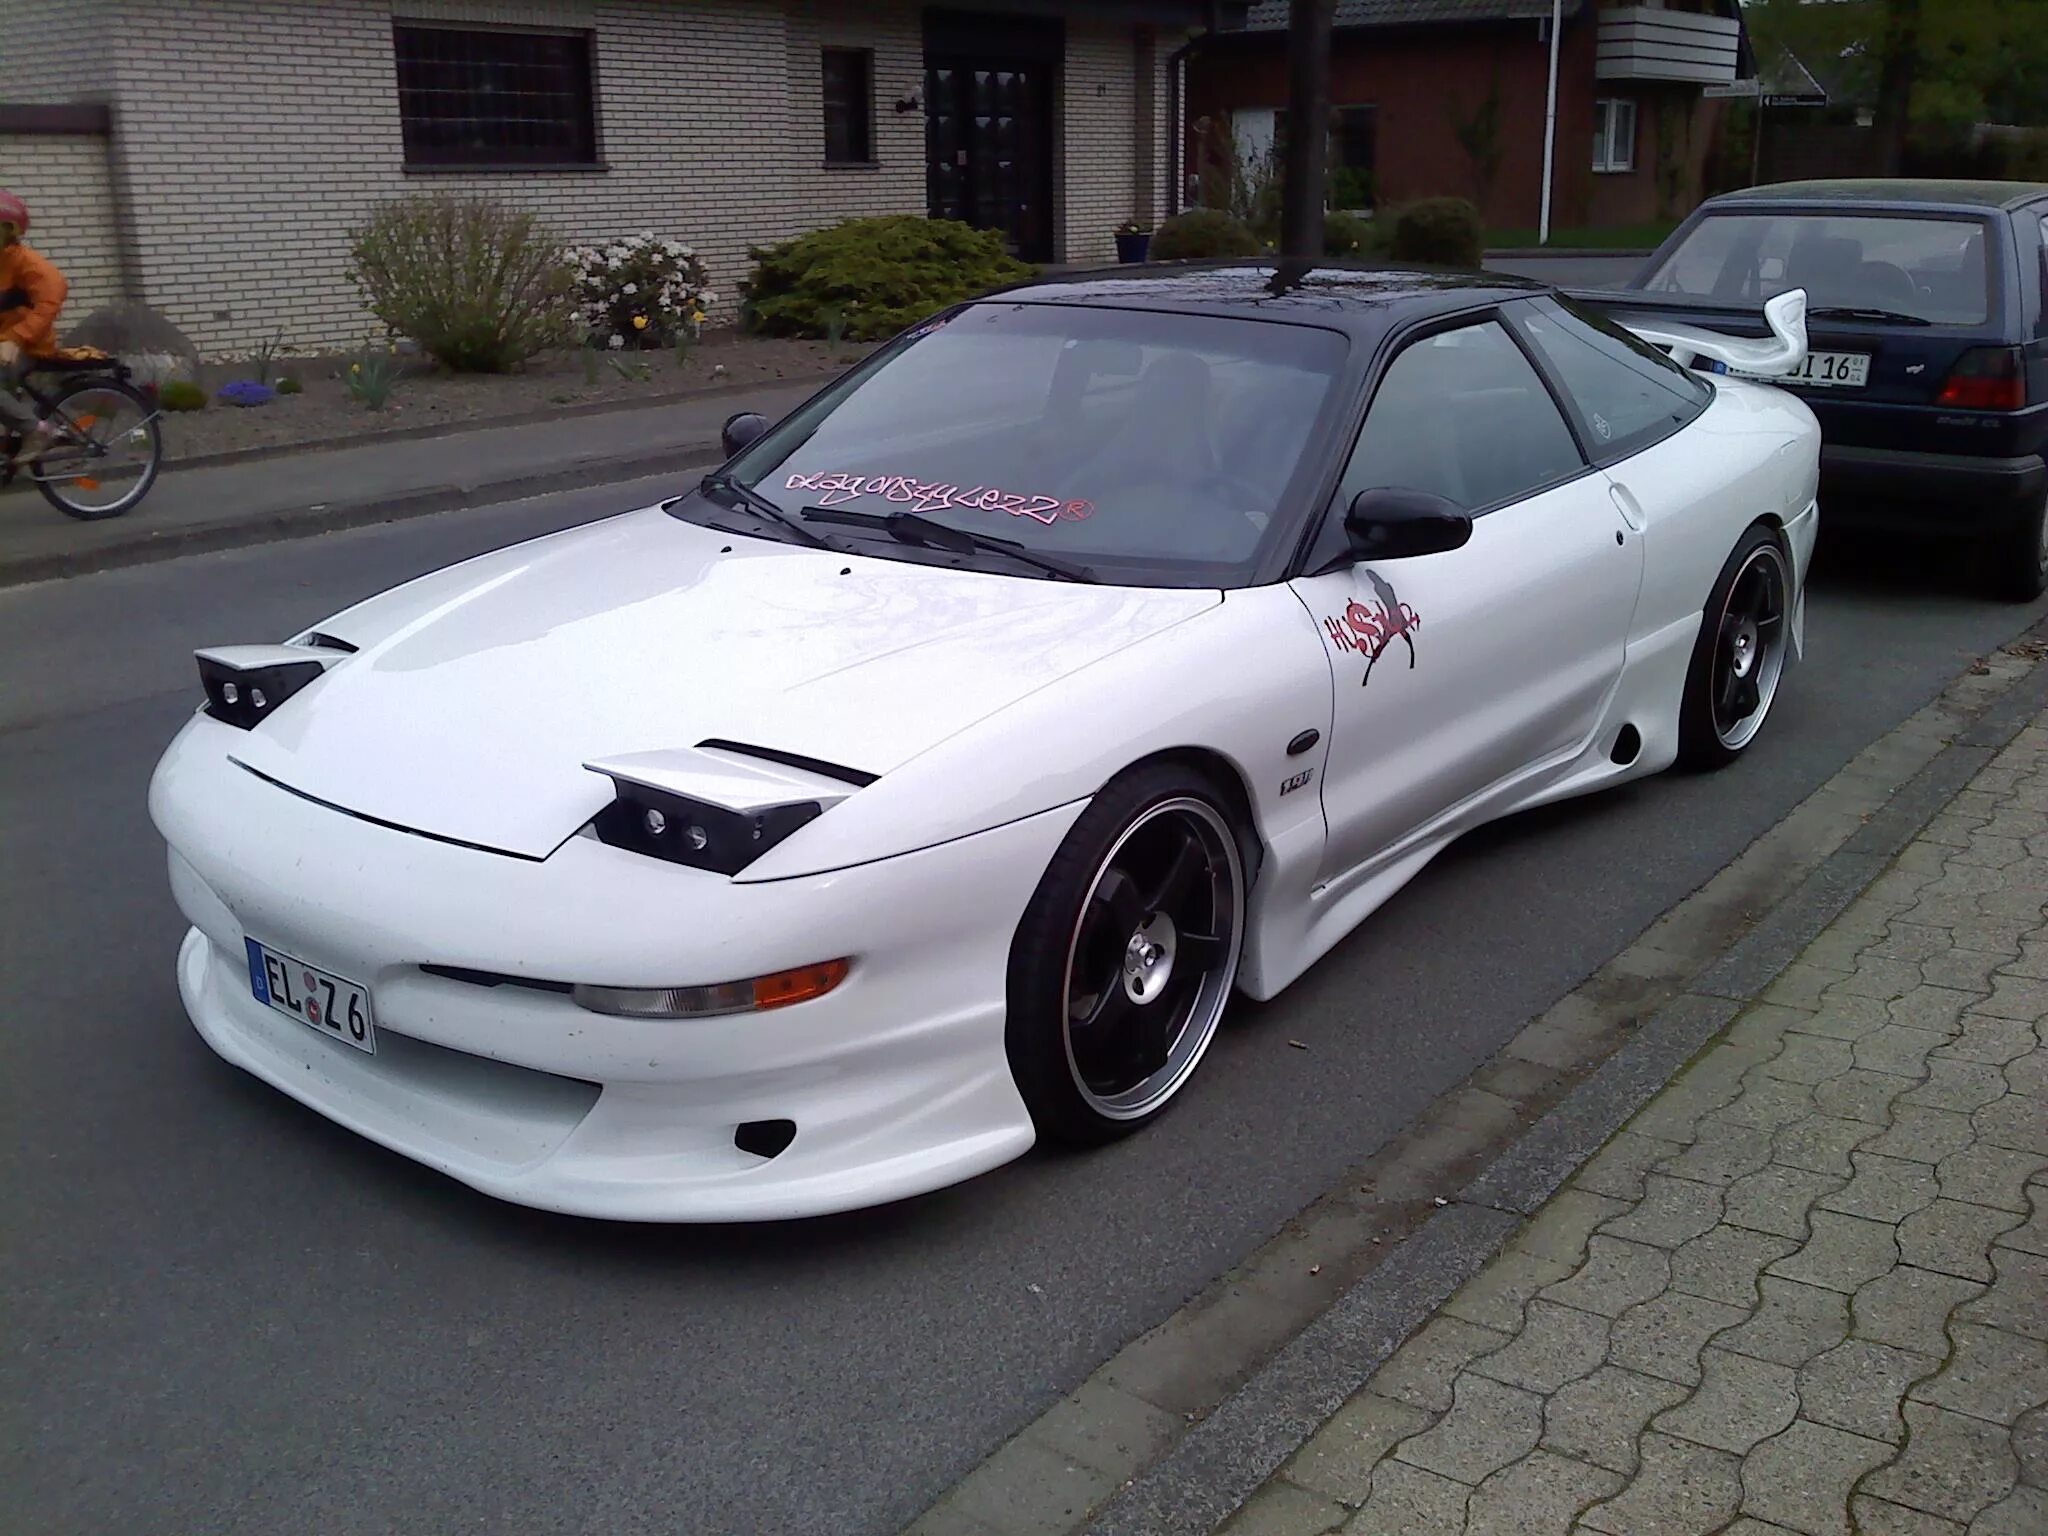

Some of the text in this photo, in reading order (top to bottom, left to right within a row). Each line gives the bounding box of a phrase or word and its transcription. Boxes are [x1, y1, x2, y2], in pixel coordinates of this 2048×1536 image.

[1821, 356, 1849, 380] 16
[264, 954, 365, 1041] EL Z 6
